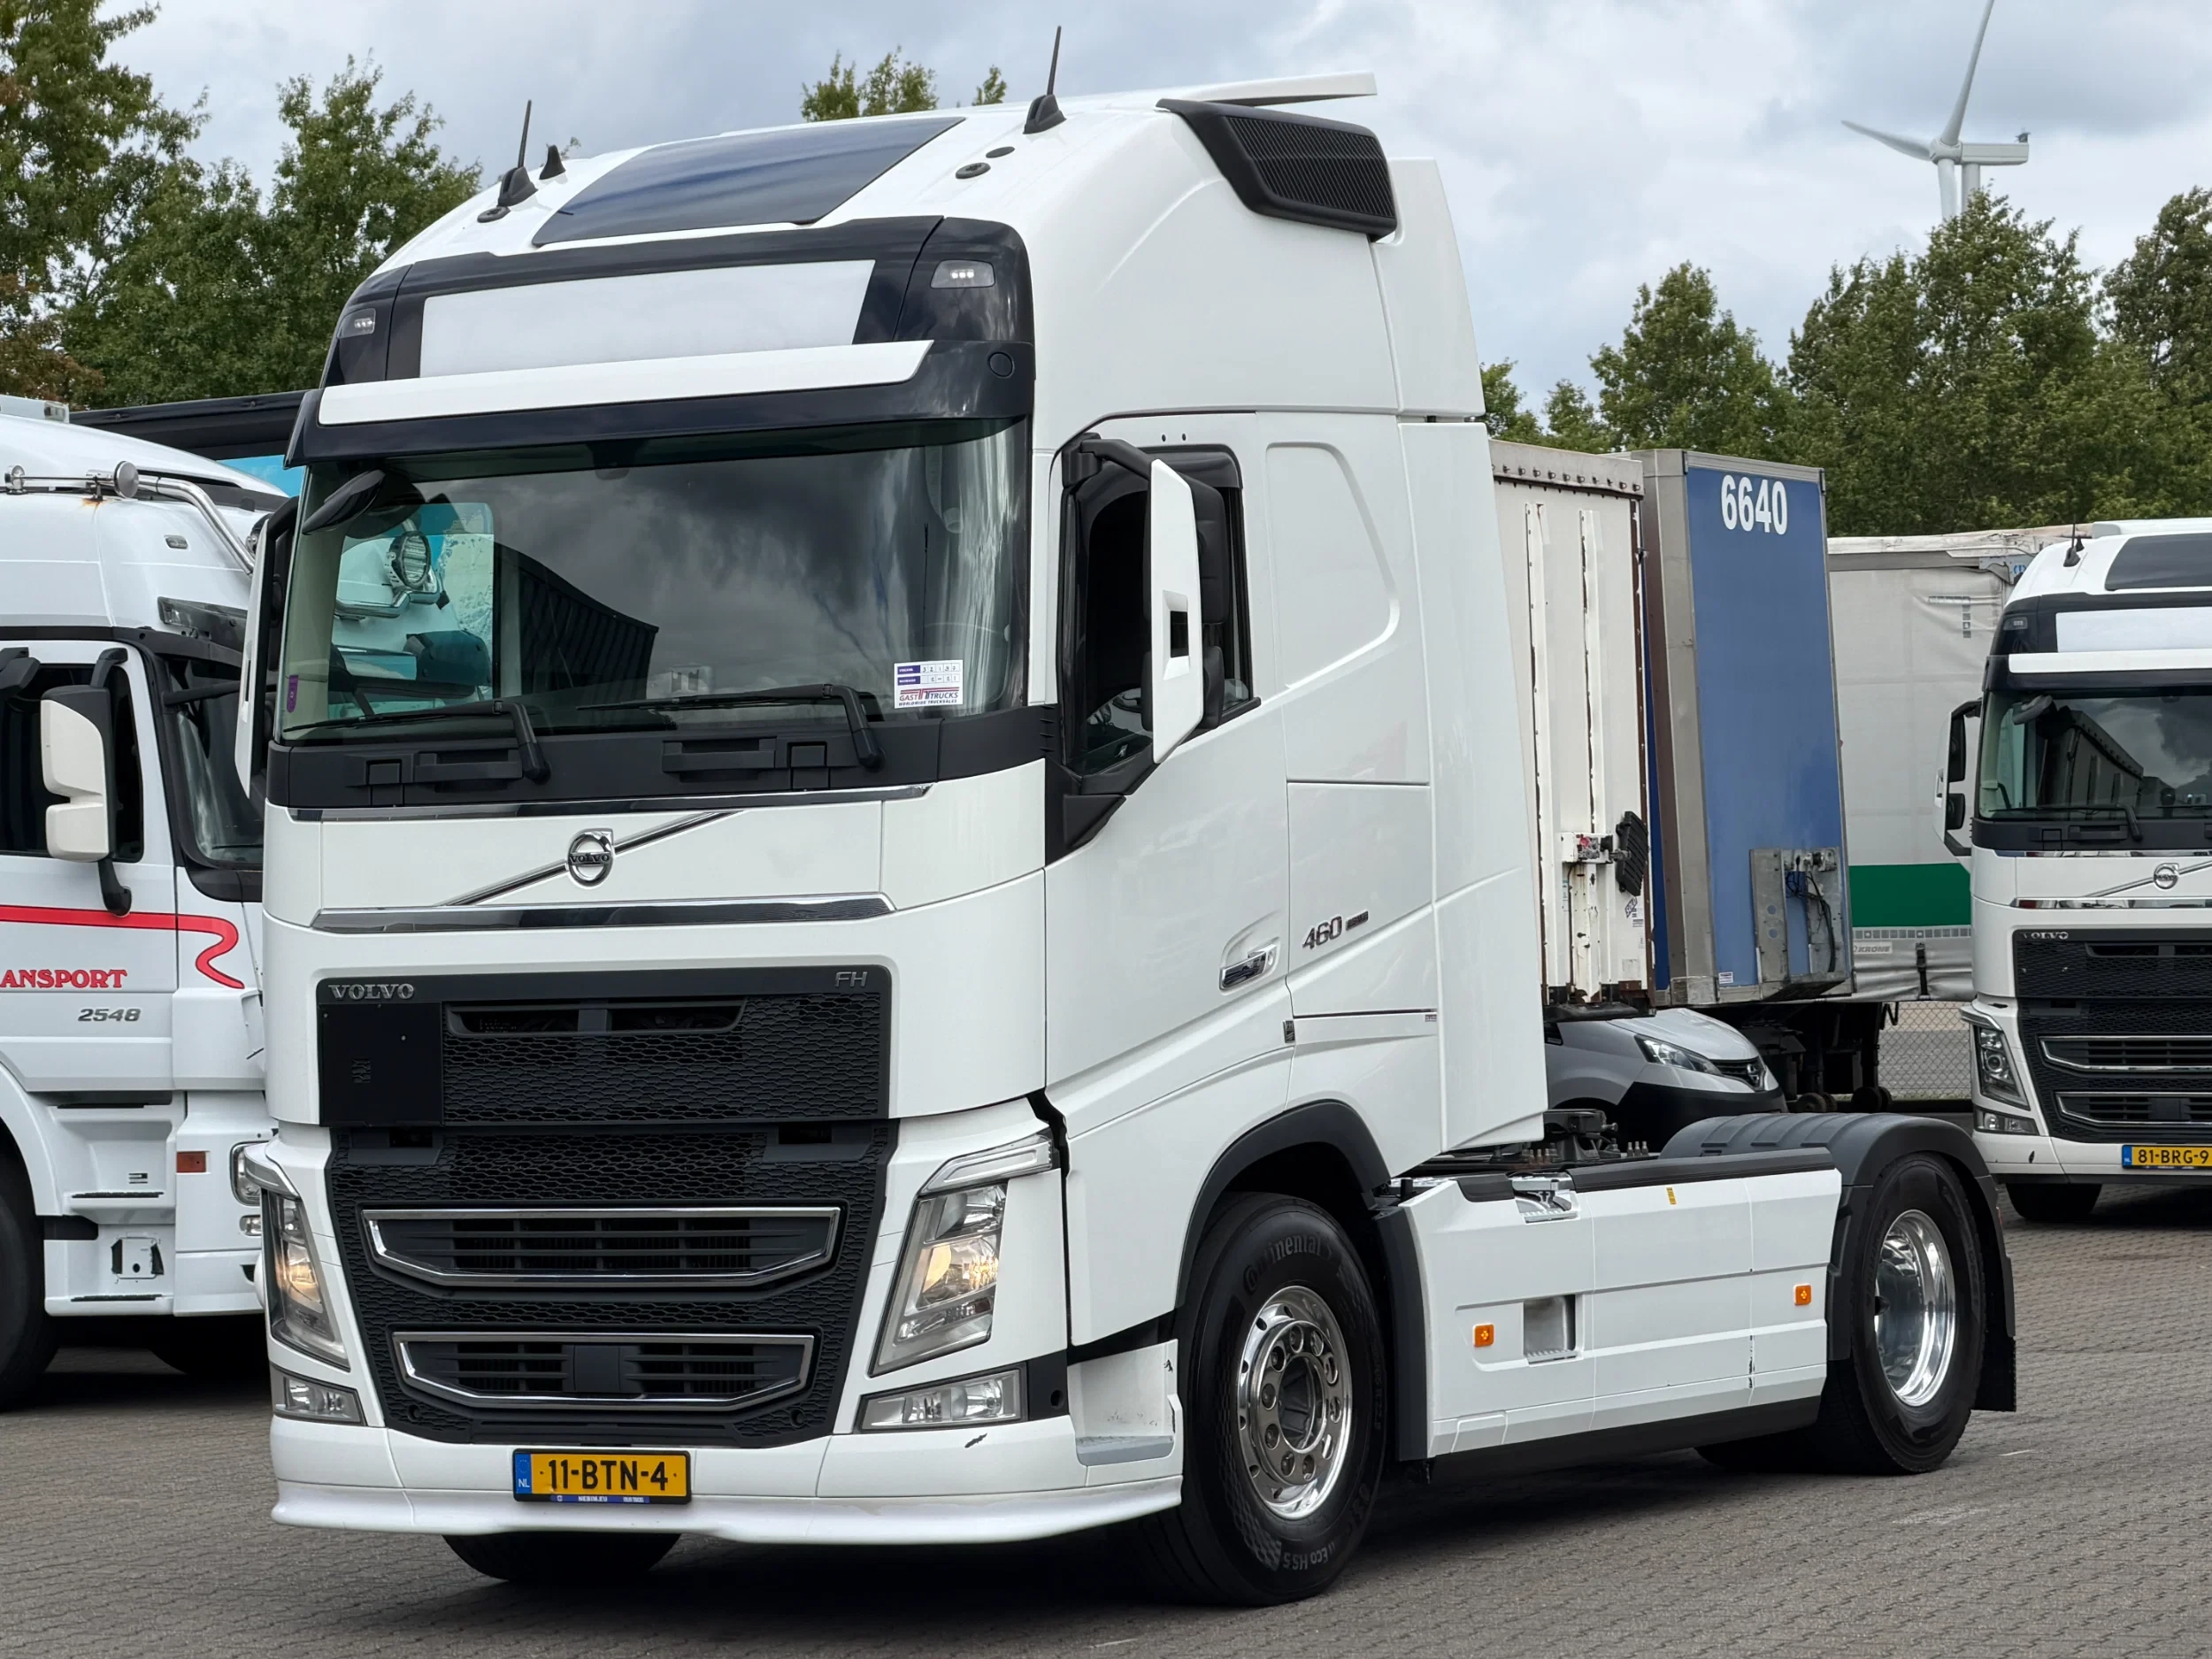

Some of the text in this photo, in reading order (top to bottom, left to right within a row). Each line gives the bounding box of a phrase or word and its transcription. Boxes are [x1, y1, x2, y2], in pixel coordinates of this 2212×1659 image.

[1721, 474, 1787, 534] 6640
[569, 855, 611, 864] VOLVO
[1302, 915, 1343, 949] 460
[0, 968, 128, 989] ANSPORT
[834, 971, 868, 987] FH
[327, 983, 415, 1000] VOLVO
[77, 1008, 142, 1022] 2548
[2138, 1148, 2209, 1164] 81-BRG-9
[518, 1478, 530, 1488] NL
[548, 1459, 669, 1492] 11-BTN-4
